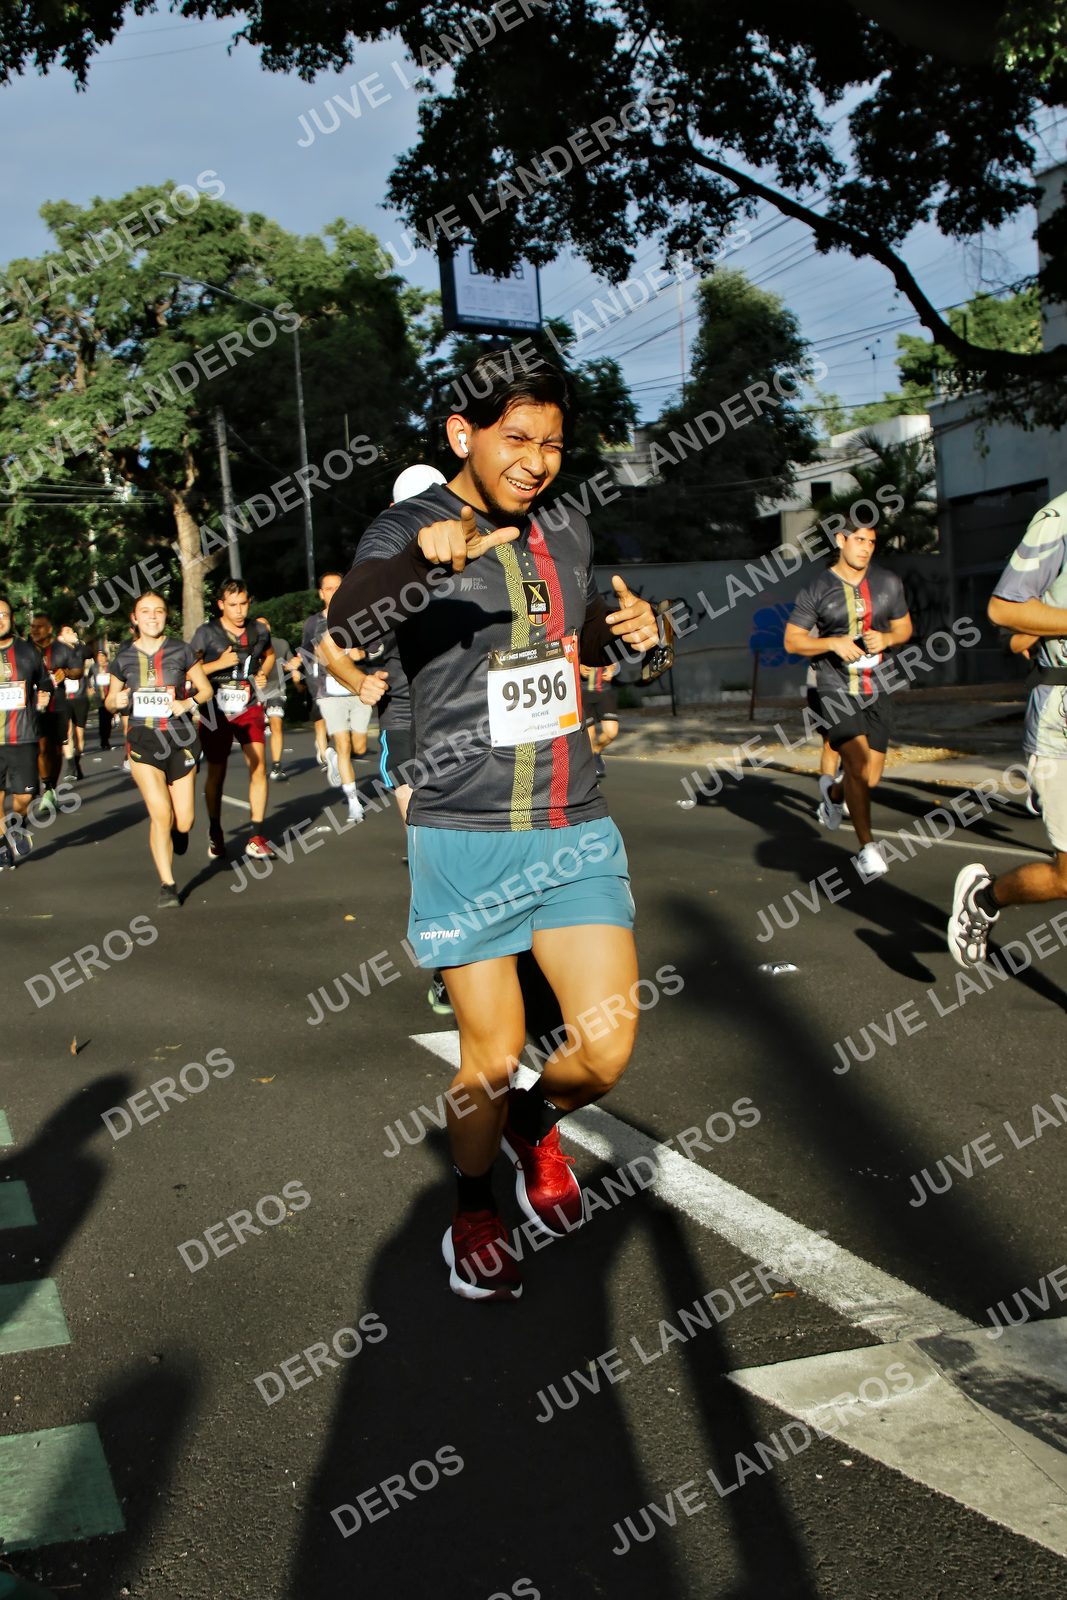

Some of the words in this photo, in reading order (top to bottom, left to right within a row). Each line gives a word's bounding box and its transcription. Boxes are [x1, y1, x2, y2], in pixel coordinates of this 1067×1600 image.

[502, 670, 567, 711] 9596
[136, 695, 170, 705] 10499
[420, 929, 460, 940] TOPTIME
